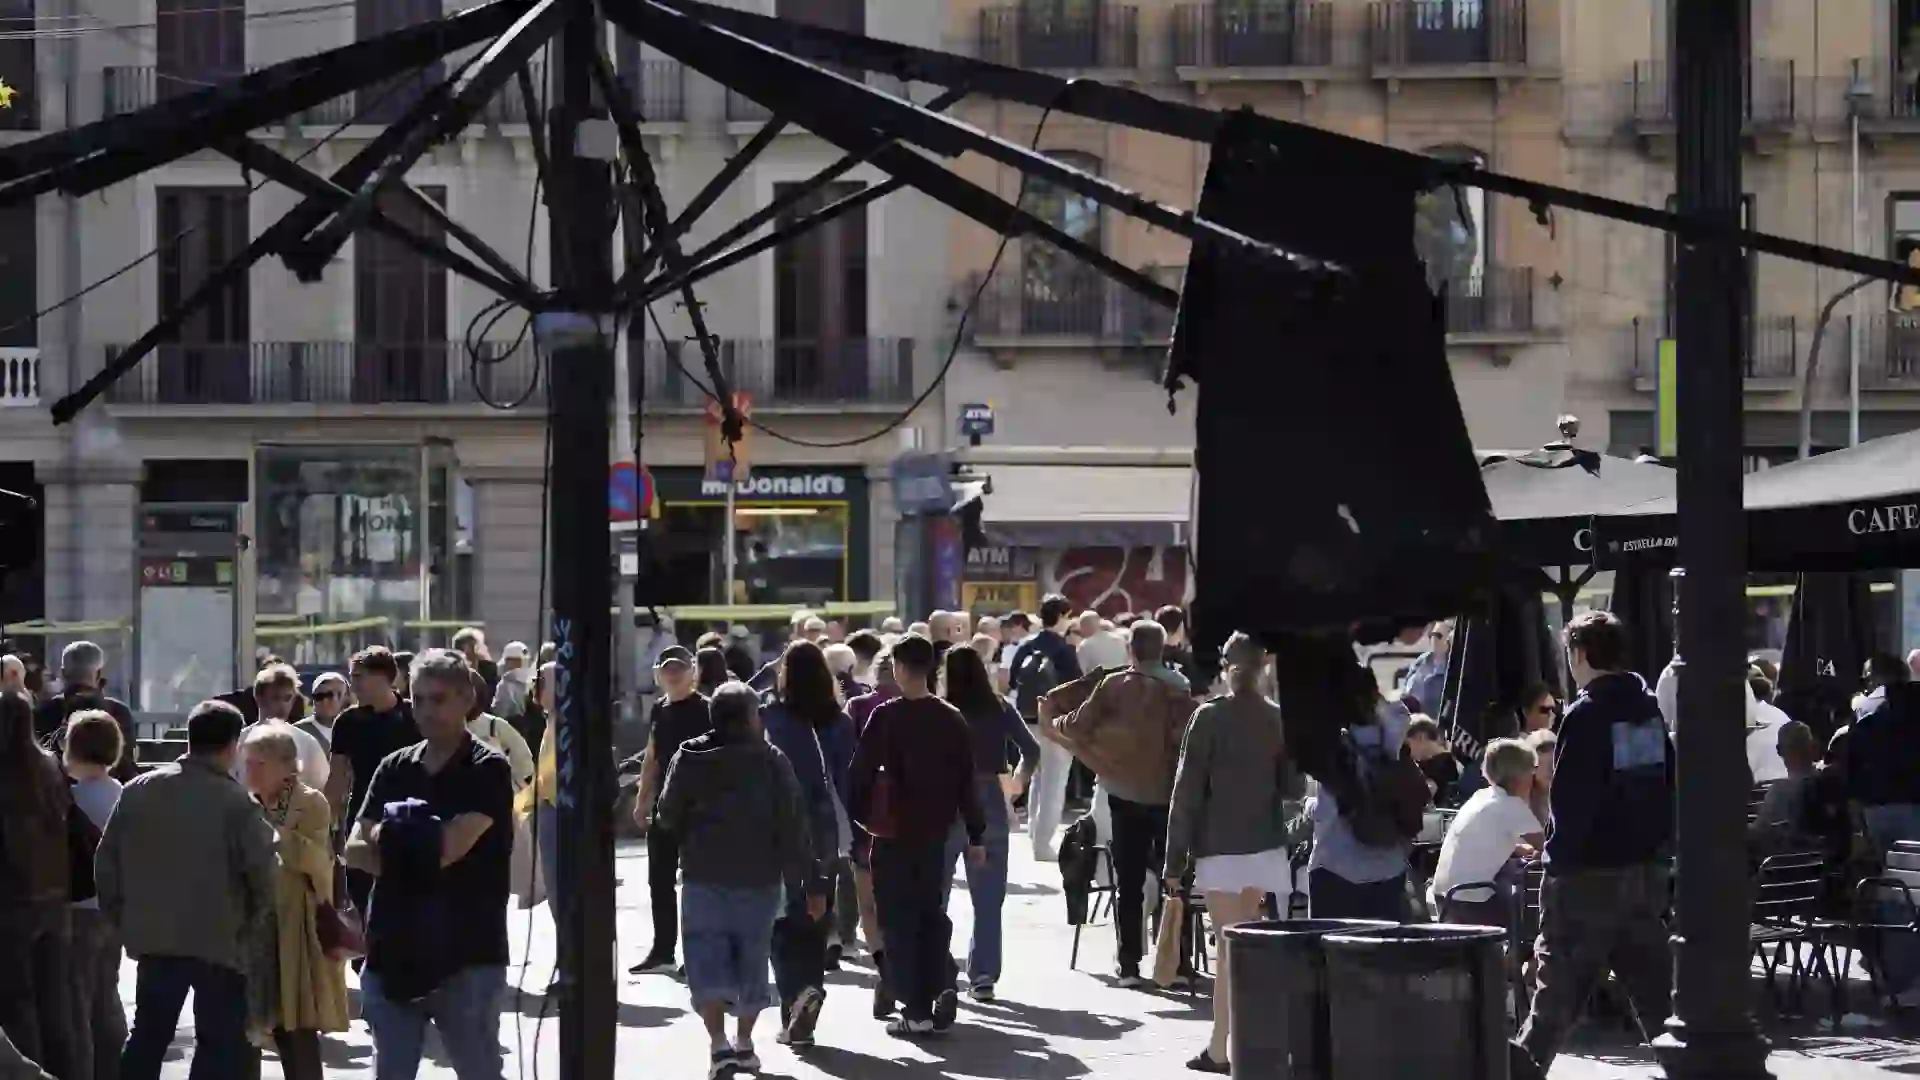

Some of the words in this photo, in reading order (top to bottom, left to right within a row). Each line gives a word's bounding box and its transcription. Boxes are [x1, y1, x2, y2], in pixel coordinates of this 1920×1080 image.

[1848, 504, 1920, 535] CAFE
[1623, 536, 1664, 552] ESTRELLA
[967, 547, 1009, 565] ATM
